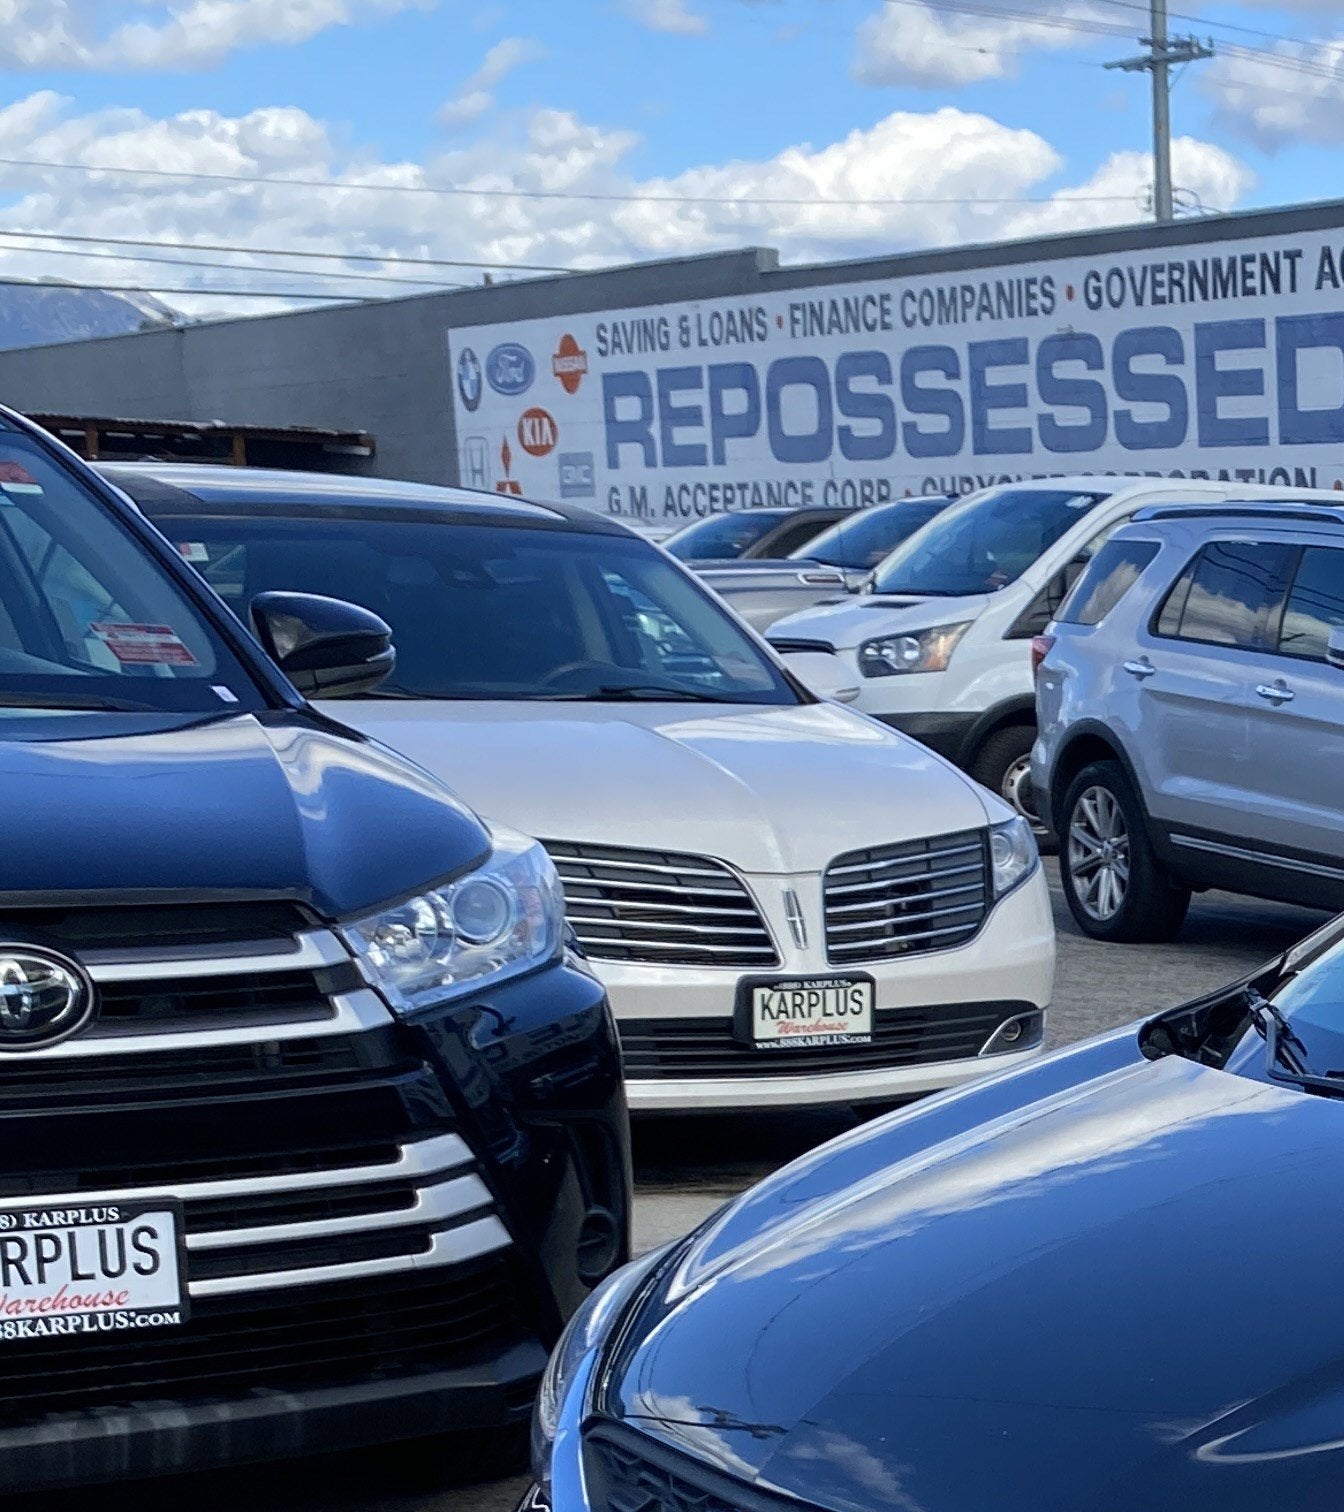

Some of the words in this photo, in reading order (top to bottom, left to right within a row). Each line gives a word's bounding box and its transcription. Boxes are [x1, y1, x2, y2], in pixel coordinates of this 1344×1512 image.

[596, 317, 670, 357] SAVING
[678, 315, 691, 348] &
[697, 307, 768, 347] LOANS
[789, 293, 893, 338] FINANCE
[901, 275, 1055, 328] COMPANIES
[1084, 249, 1303, 310] GOVERNMENT
[522, 416, 554, 446] KIA
[606, 485, 656, 518] G.M.
[662, 480, 814, 518] ACCEPTANCE
[760, 988, 864, 1021] KARPLUS
[775, 1017, 848, 1034] Warehouse
[22, 1206, 121, 1229] KARPLUS
[0, 1283, 130, 1316] arehouse
